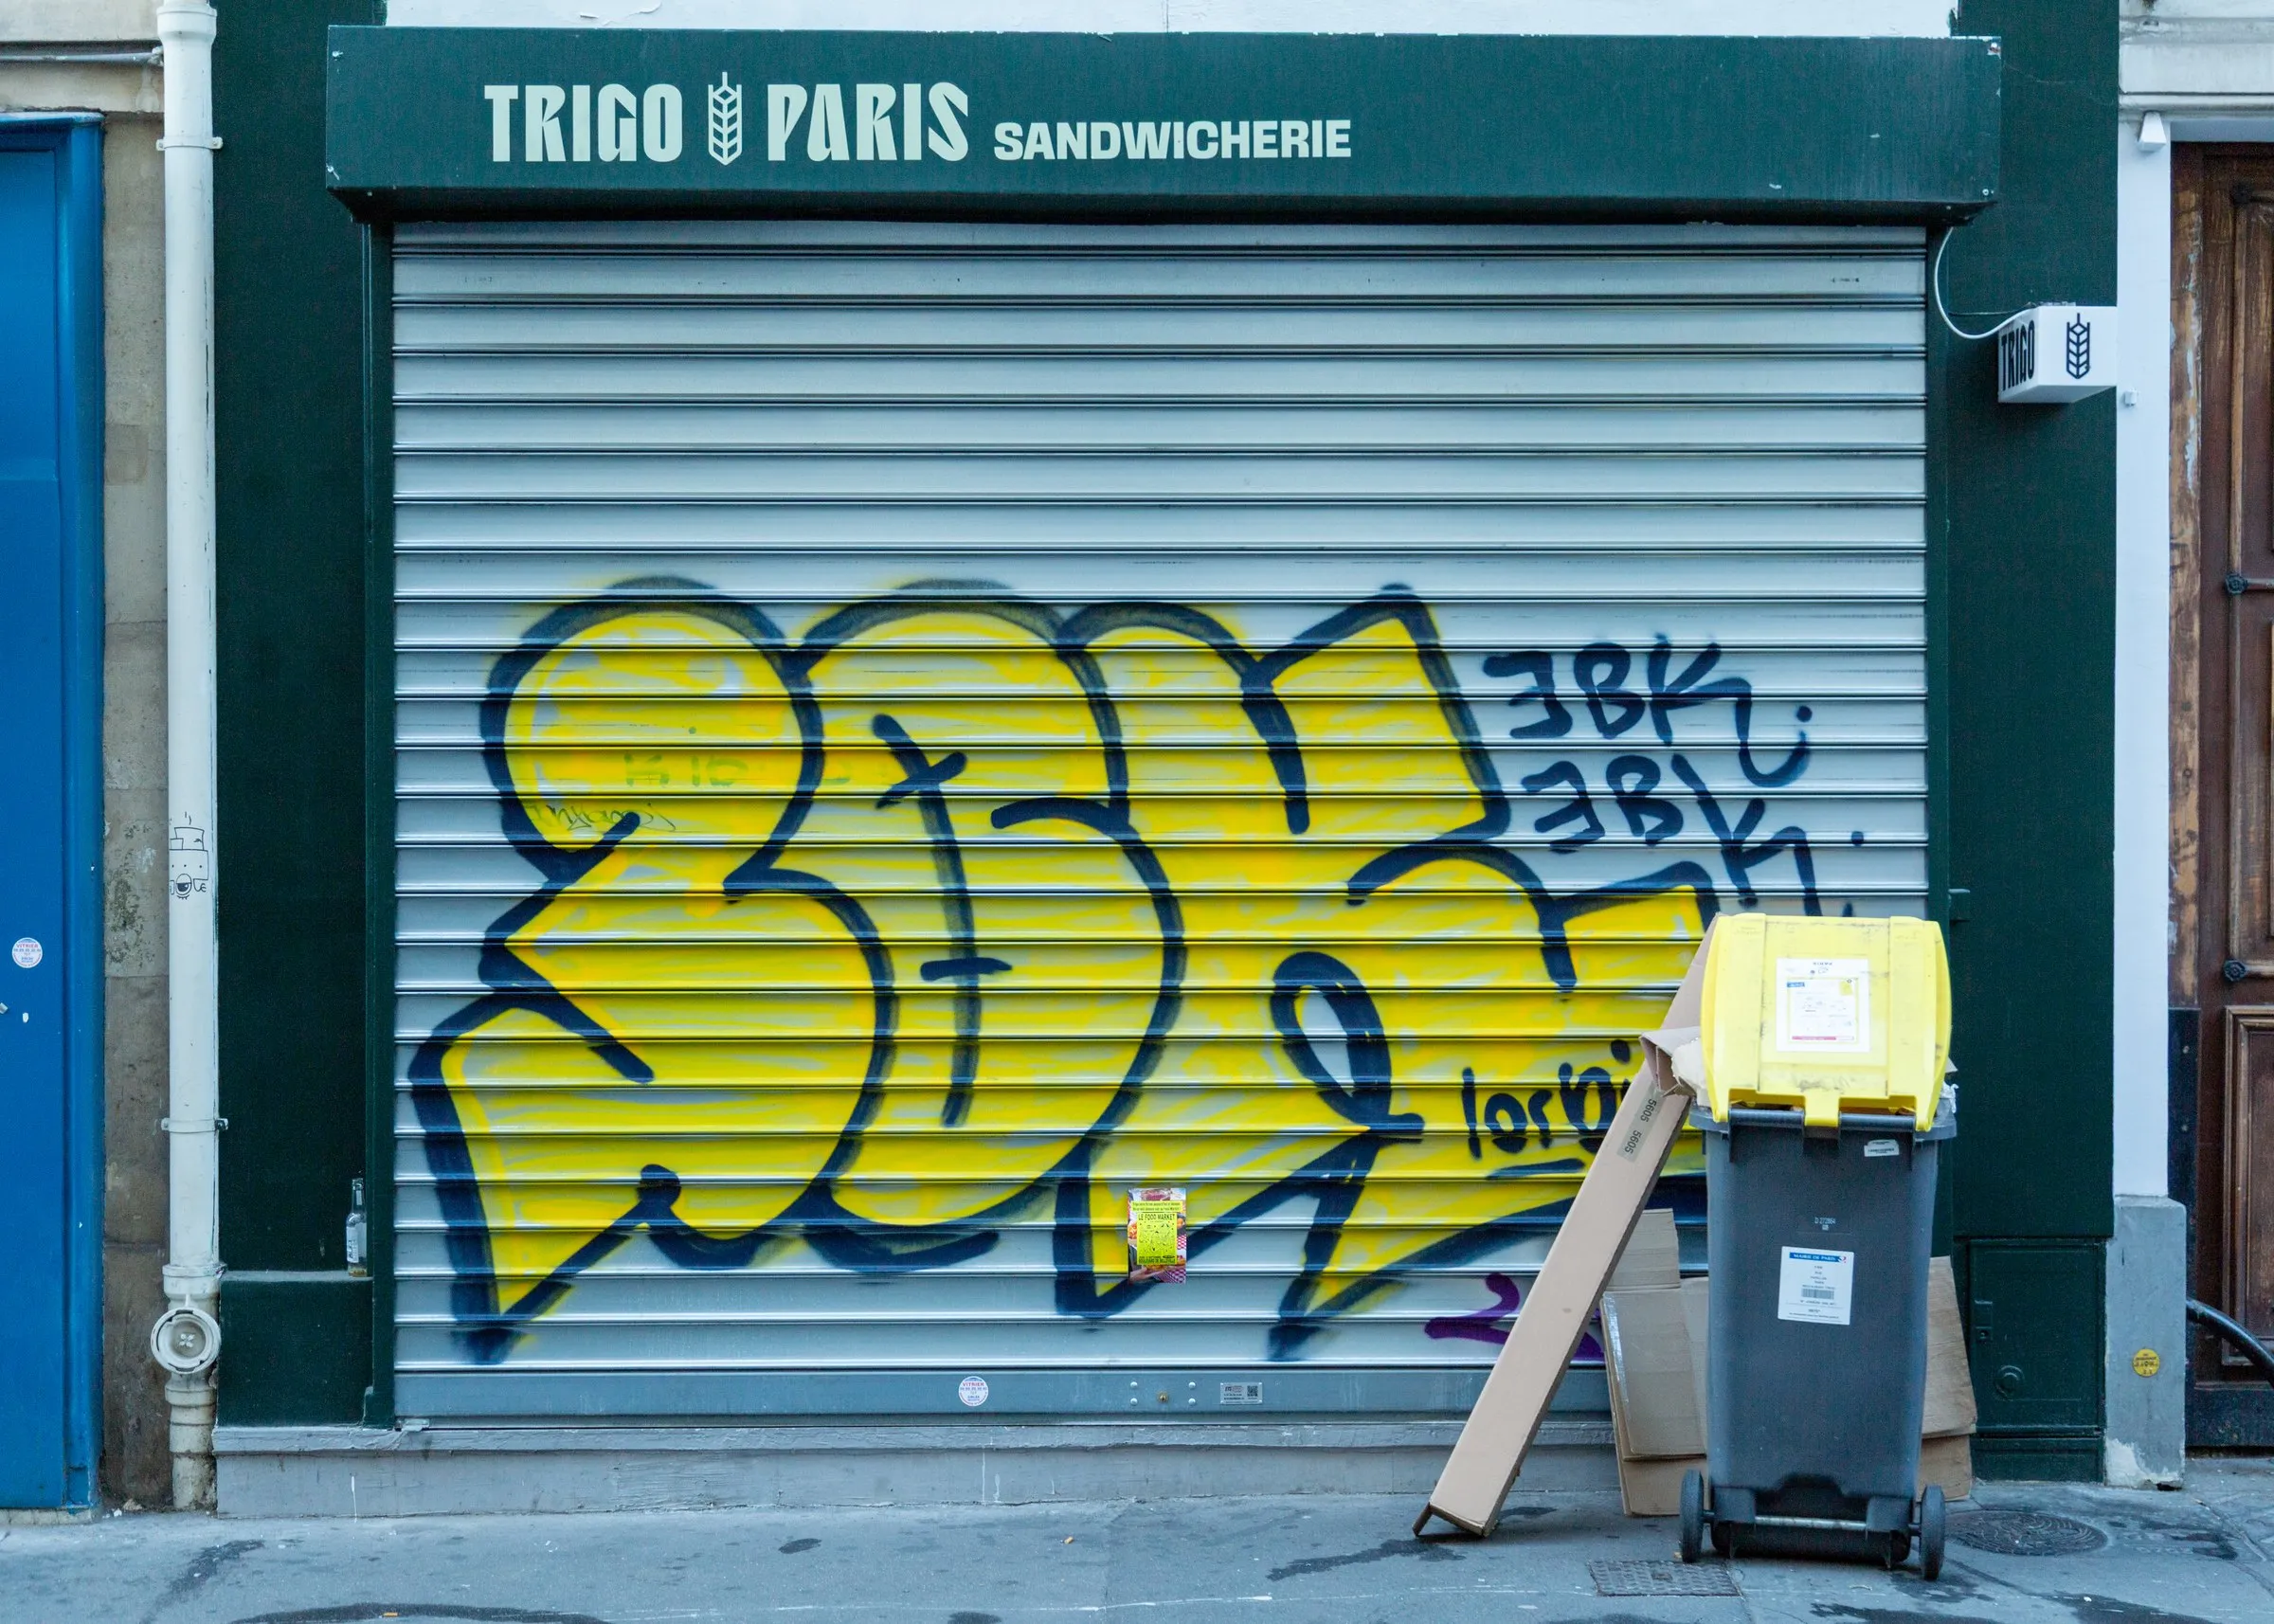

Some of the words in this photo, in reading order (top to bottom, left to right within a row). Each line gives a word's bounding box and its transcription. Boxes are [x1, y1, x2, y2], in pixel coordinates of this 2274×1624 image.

[484, 83, 683, 163] TRIGO
[767, 81, 968, 162] PARIS
[994, 119, 1351, 161] SANDWICHERIE
[2001, 319, 2035, 391] TRIGO
[1640, 1099, 1657, 1123] 5605
[1624, 1130, 1642, 1154] 5605
